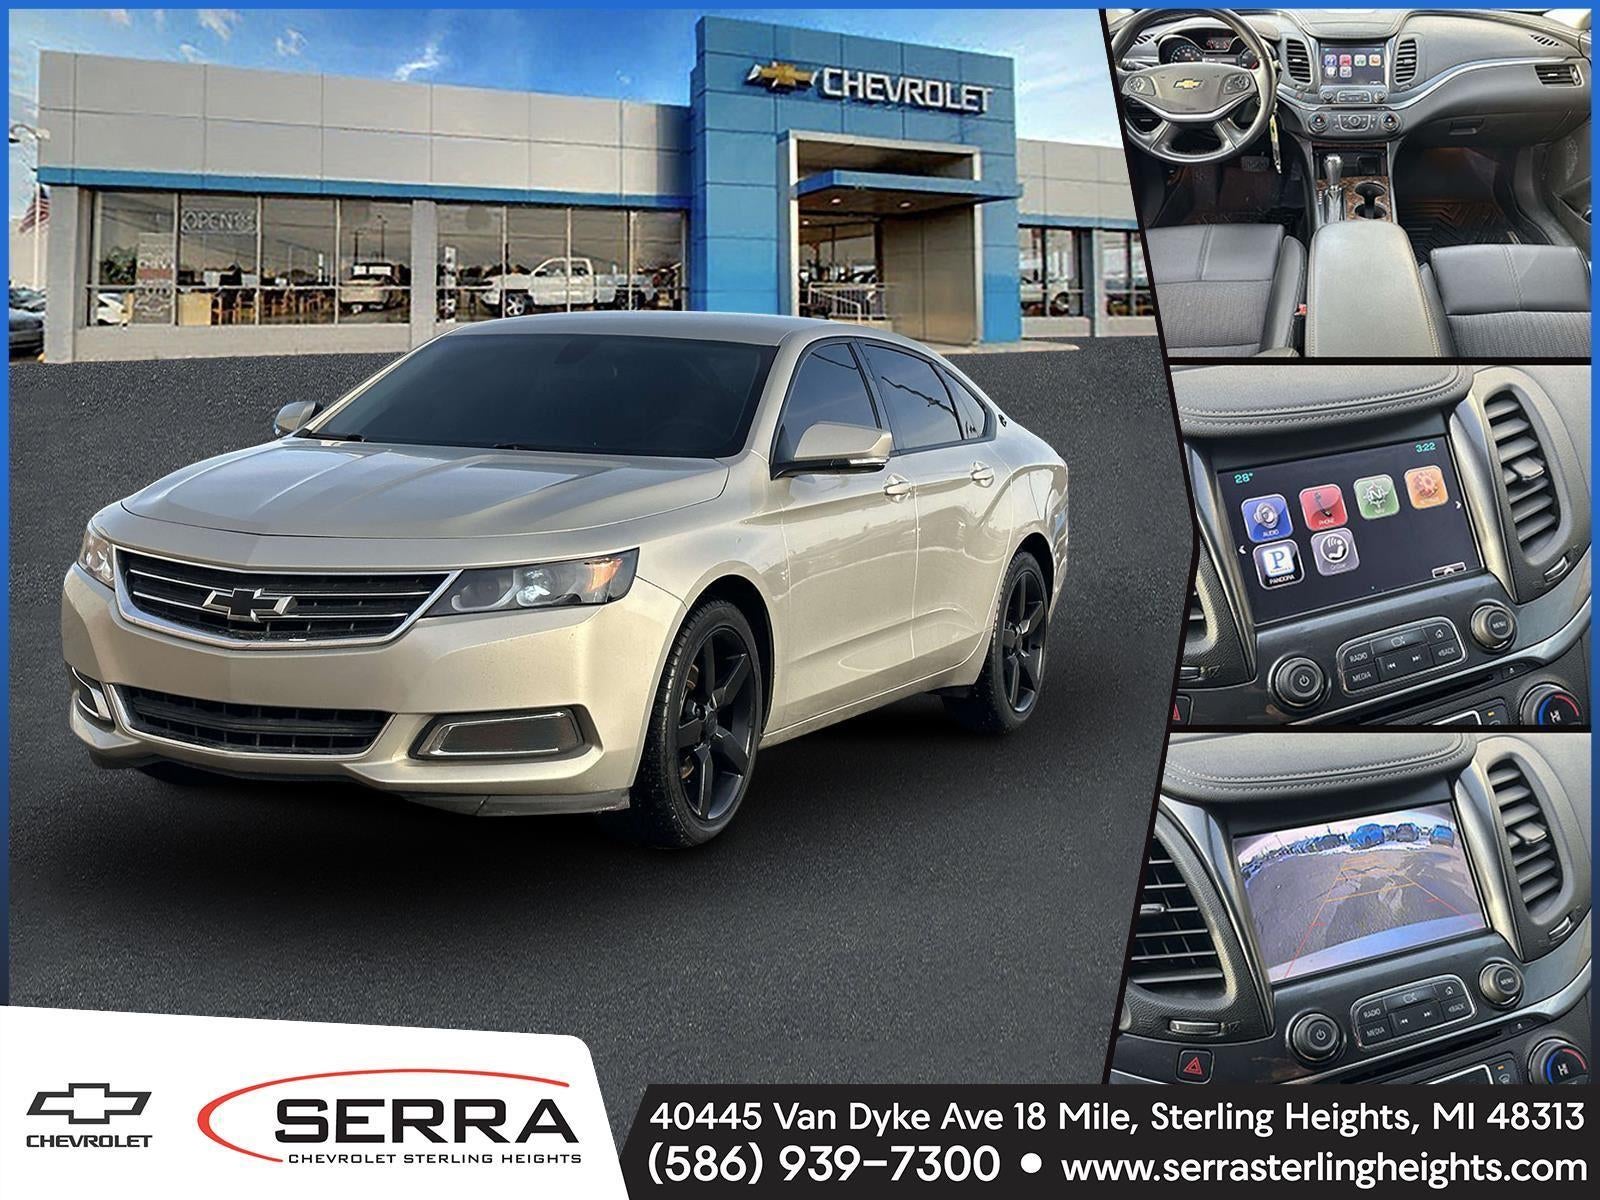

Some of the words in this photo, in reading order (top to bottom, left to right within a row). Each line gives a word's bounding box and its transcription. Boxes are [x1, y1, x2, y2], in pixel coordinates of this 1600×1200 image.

[822, 66, 993, 112] CHEVROLET
[1269, 574, 1296, 585] PANDORA
[1349, 652, 1369, 663] RADIO
[1352, 672, 1373, 682] MEDIA
[1362, 1008, 1382, 1018] RADIO
[1366, 1026, 1386, 1037] MEDIA
